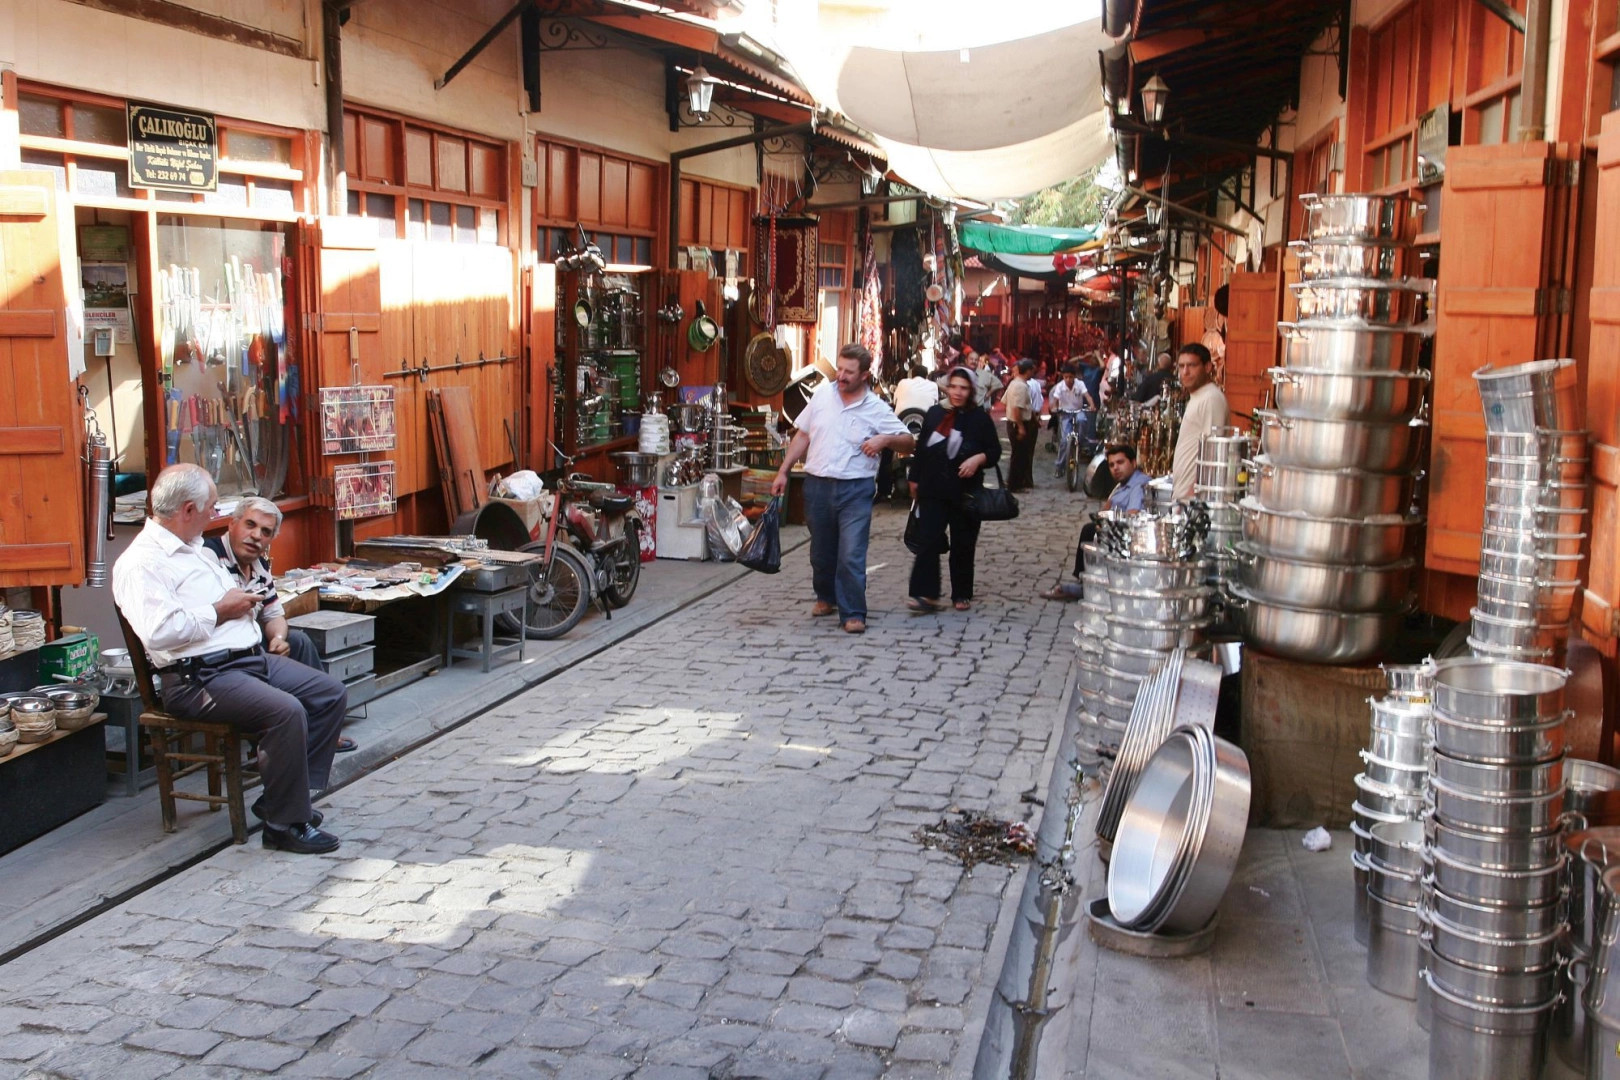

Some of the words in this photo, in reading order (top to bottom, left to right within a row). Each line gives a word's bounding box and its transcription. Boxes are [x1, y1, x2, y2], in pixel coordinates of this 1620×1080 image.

[138, 116, 206, 140] ÇALIKOĞLU
[145, 168, 156, 179] Tel:
[157, 169, 169, 180] 232
[178, 172, 186, 181] 74
